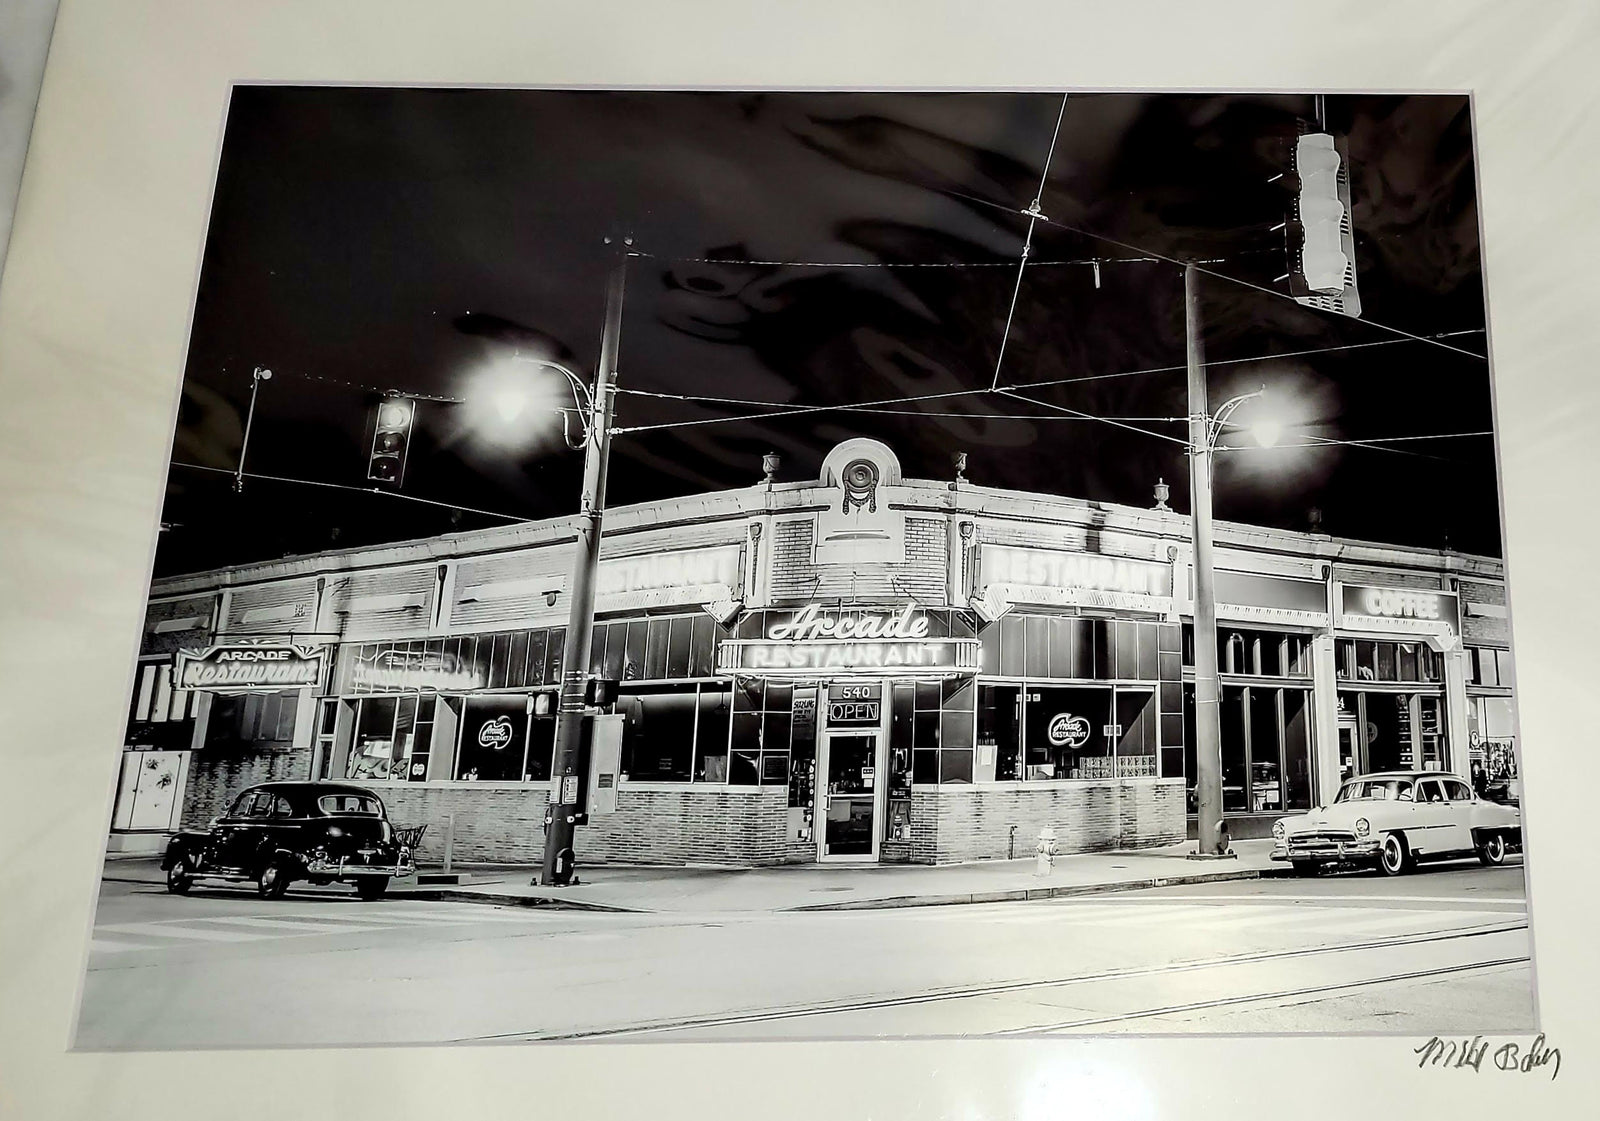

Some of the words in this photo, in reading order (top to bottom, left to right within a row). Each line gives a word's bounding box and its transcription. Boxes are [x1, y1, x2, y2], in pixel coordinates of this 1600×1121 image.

[1364, 589, 1440, 619] COFFEE
[768, 602, 930, 640] Arcade
[216, 650, 292, 664] ARCADE
[751, 643, 944, 668] RESTAURANT
[183, 660, 318, 686] Restaurant
[842, 686, 871, 699] 540
[832, 703, 877, 720] OPEN
